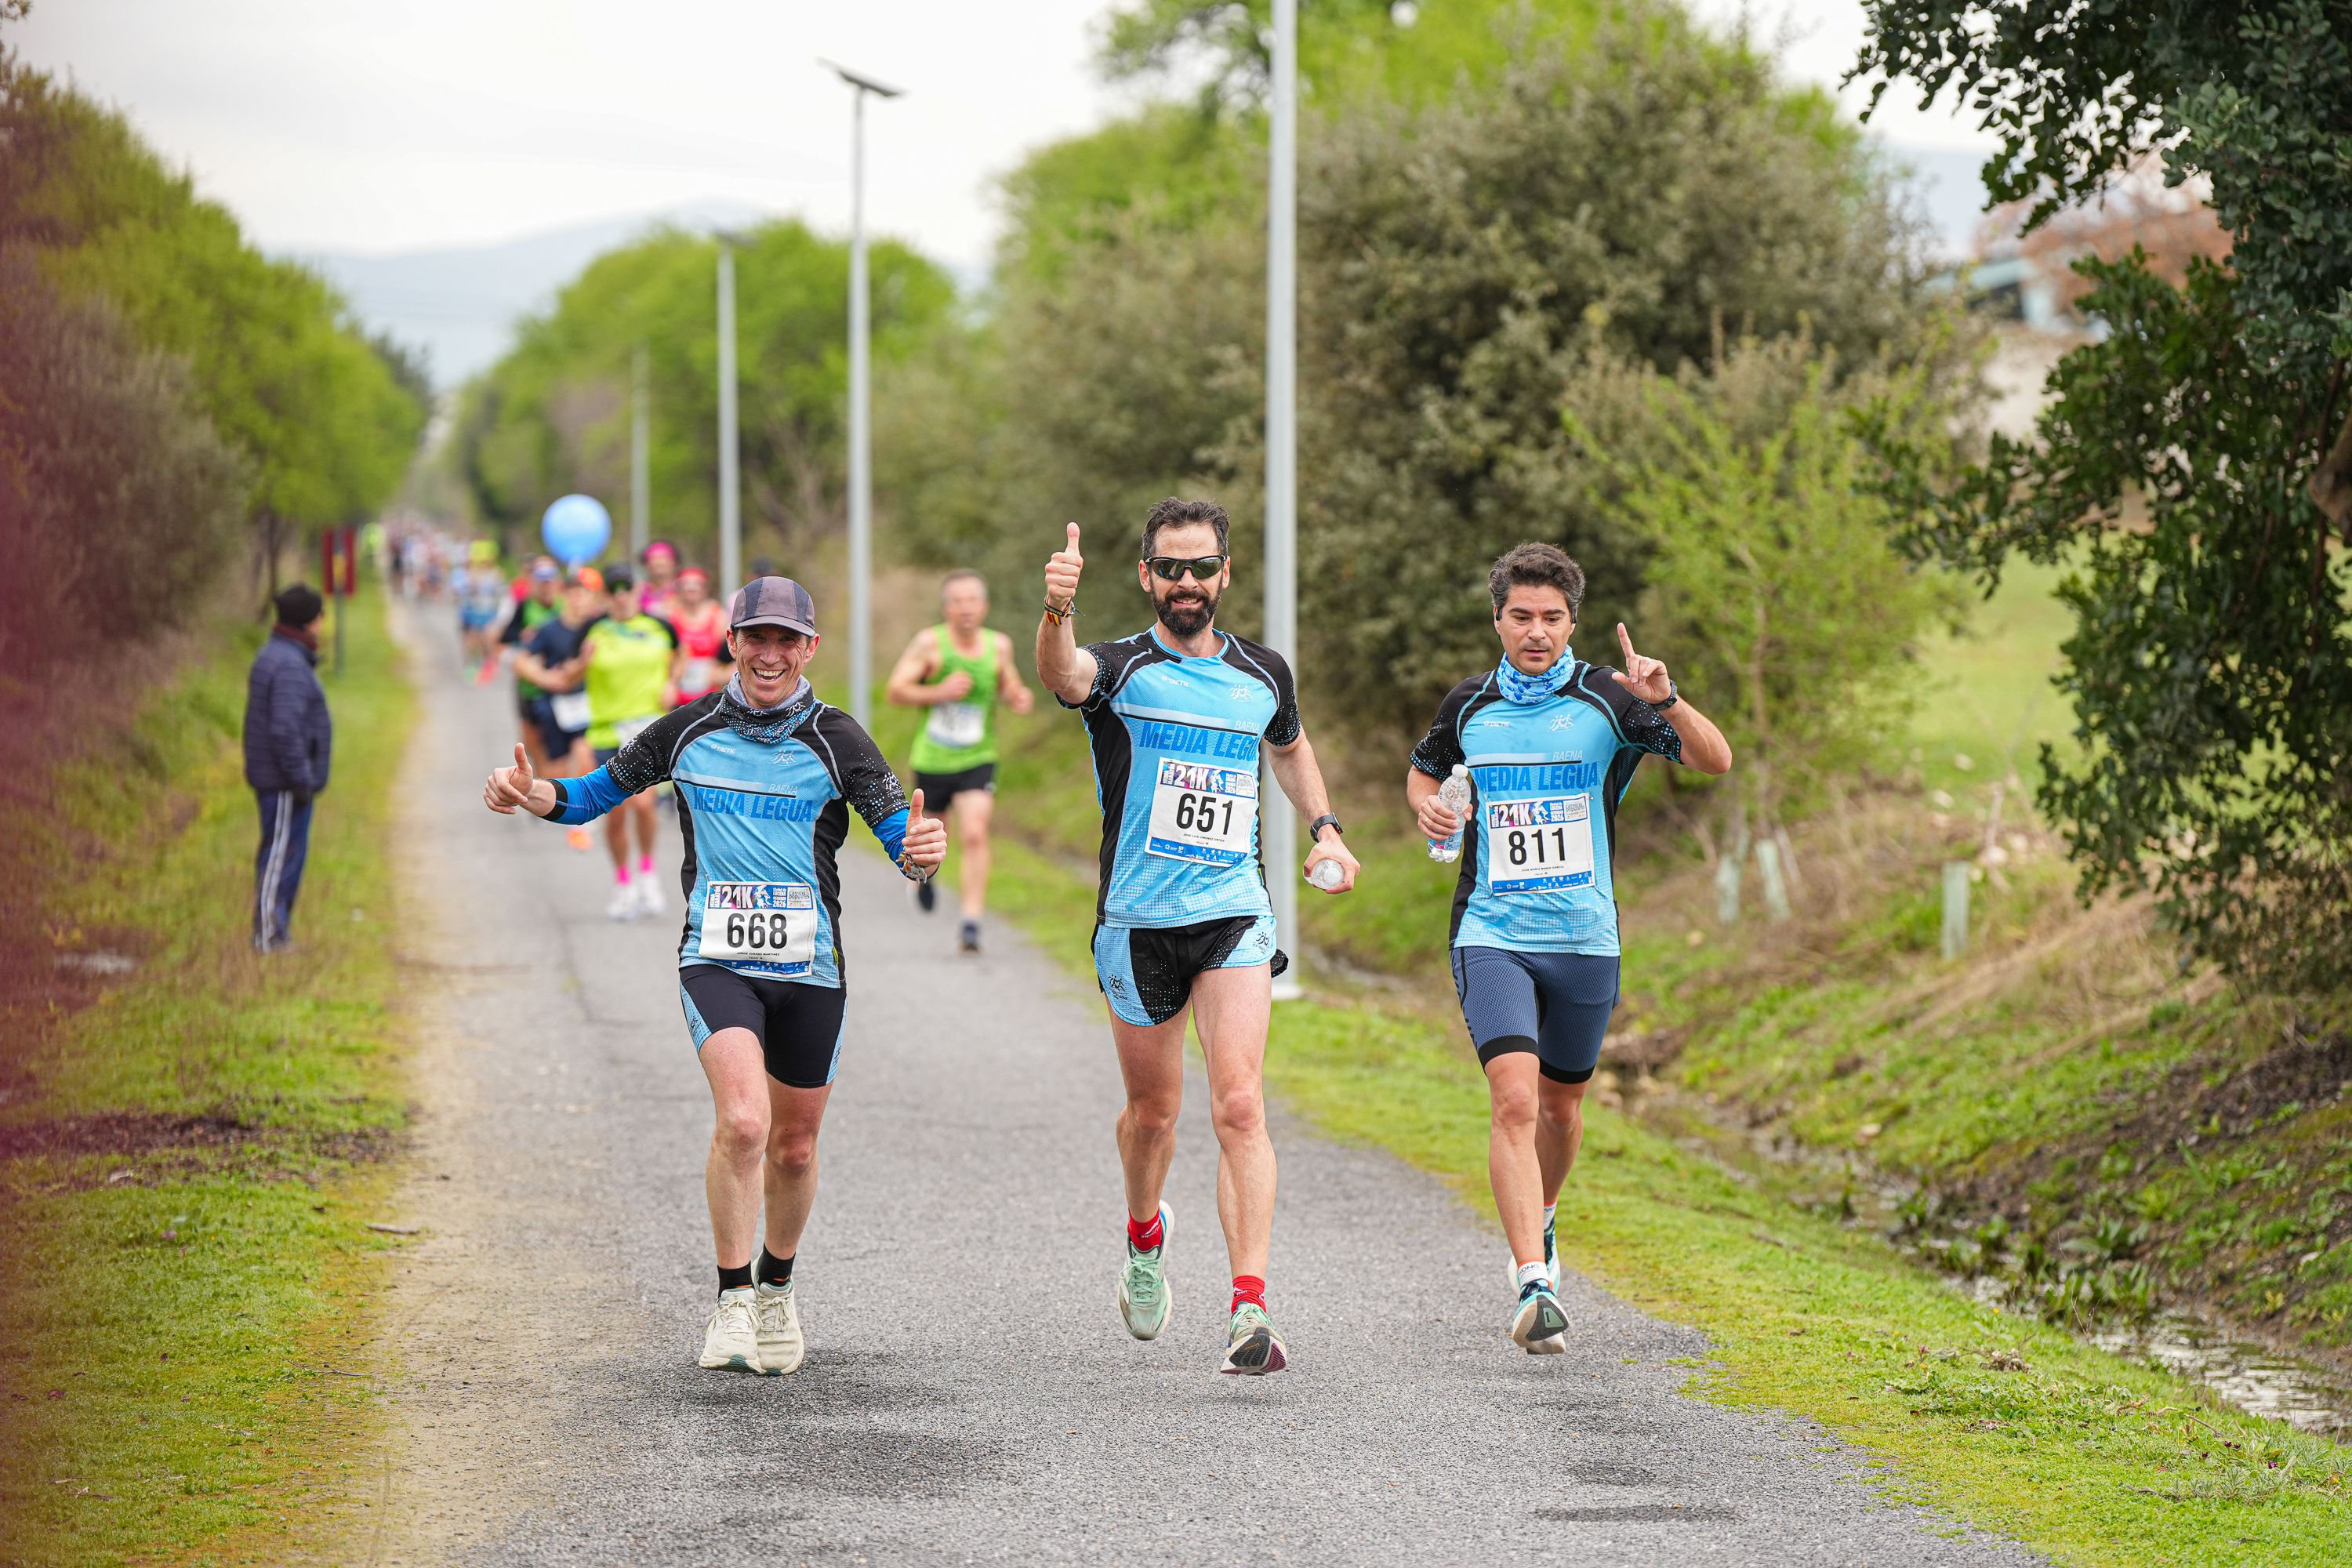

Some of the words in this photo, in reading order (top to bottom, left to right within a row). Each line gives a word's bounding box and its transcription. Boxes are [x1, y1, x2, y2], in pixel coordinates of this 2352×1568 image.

[1168, 677, 1189, 687] TACTIC
[1235, 720, 1261, 732] BAENA
[1139, 721, 1209, 754] MEDIA
[1213, 731, 1259, 761] LEGU
[1552, 750, 1583, 761] BAENA
[768, 783, 797, 796] BAENA
[1174, 764, 1209, 790] 21K
[1474, 766, 1532, 792] MEDIA
[1538, 761, 1599, 791] LEGUA
[694, 786, 745, 816] MEDIA
[750, 795, 814, 822] LEGUA
[1176, 793, 1233, 836] 651
[1498, 803, 1532, 827] 21K
[1508, 827, 1566, 866] 811
[720, 885, 753, 908] 21K
[727, 913, 787, 949] 668
